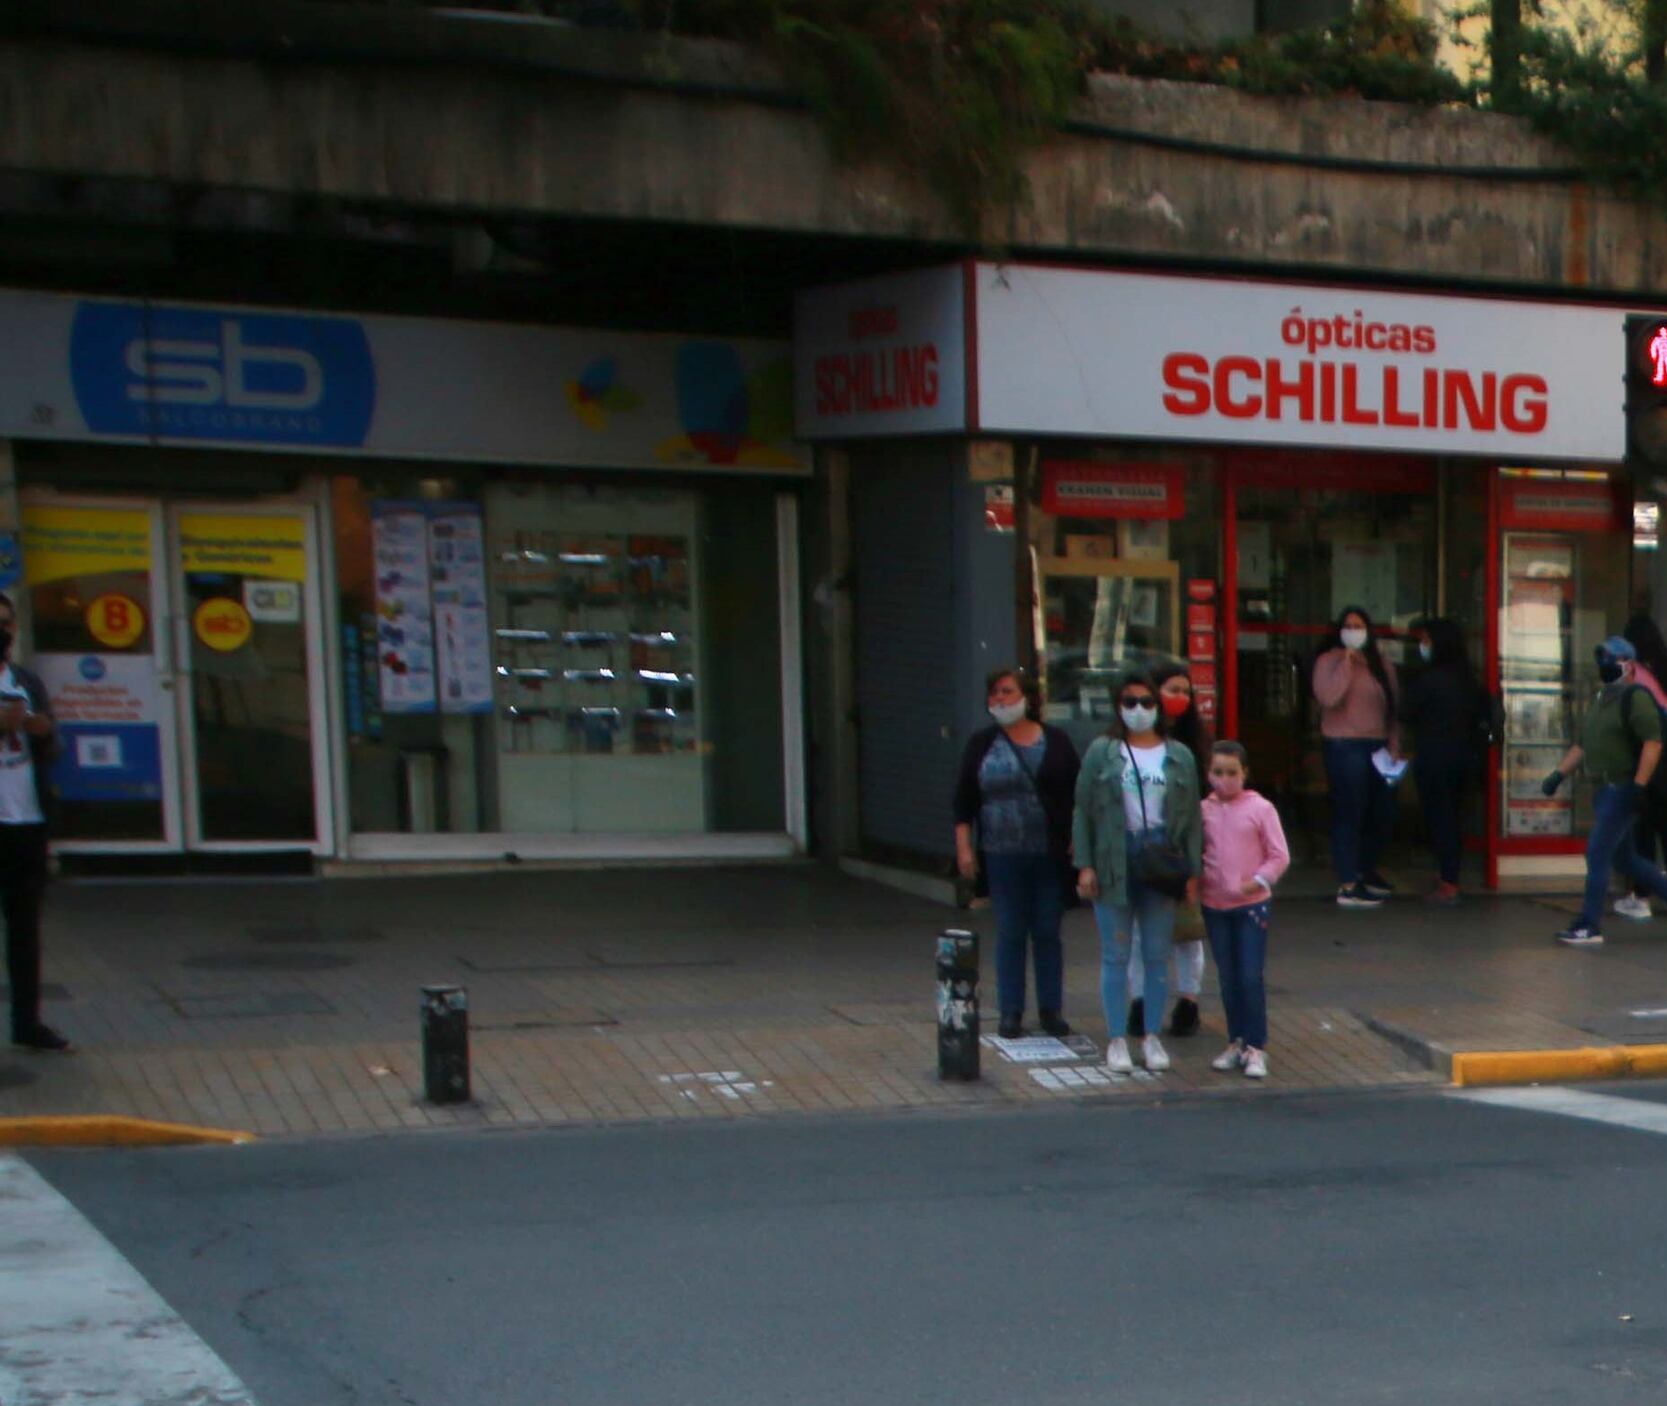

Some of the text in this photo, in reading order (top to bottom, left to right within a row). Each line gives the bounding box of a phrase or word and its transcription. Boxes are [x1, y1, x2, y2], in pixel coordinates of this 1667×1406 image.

[125, 320, 322, 410] sb
[1281, 307, 1436, 354] ópticas
[815, 342, 938, 417] SCHILLING
[1162, 351, 1548, 434] SCHILLING
